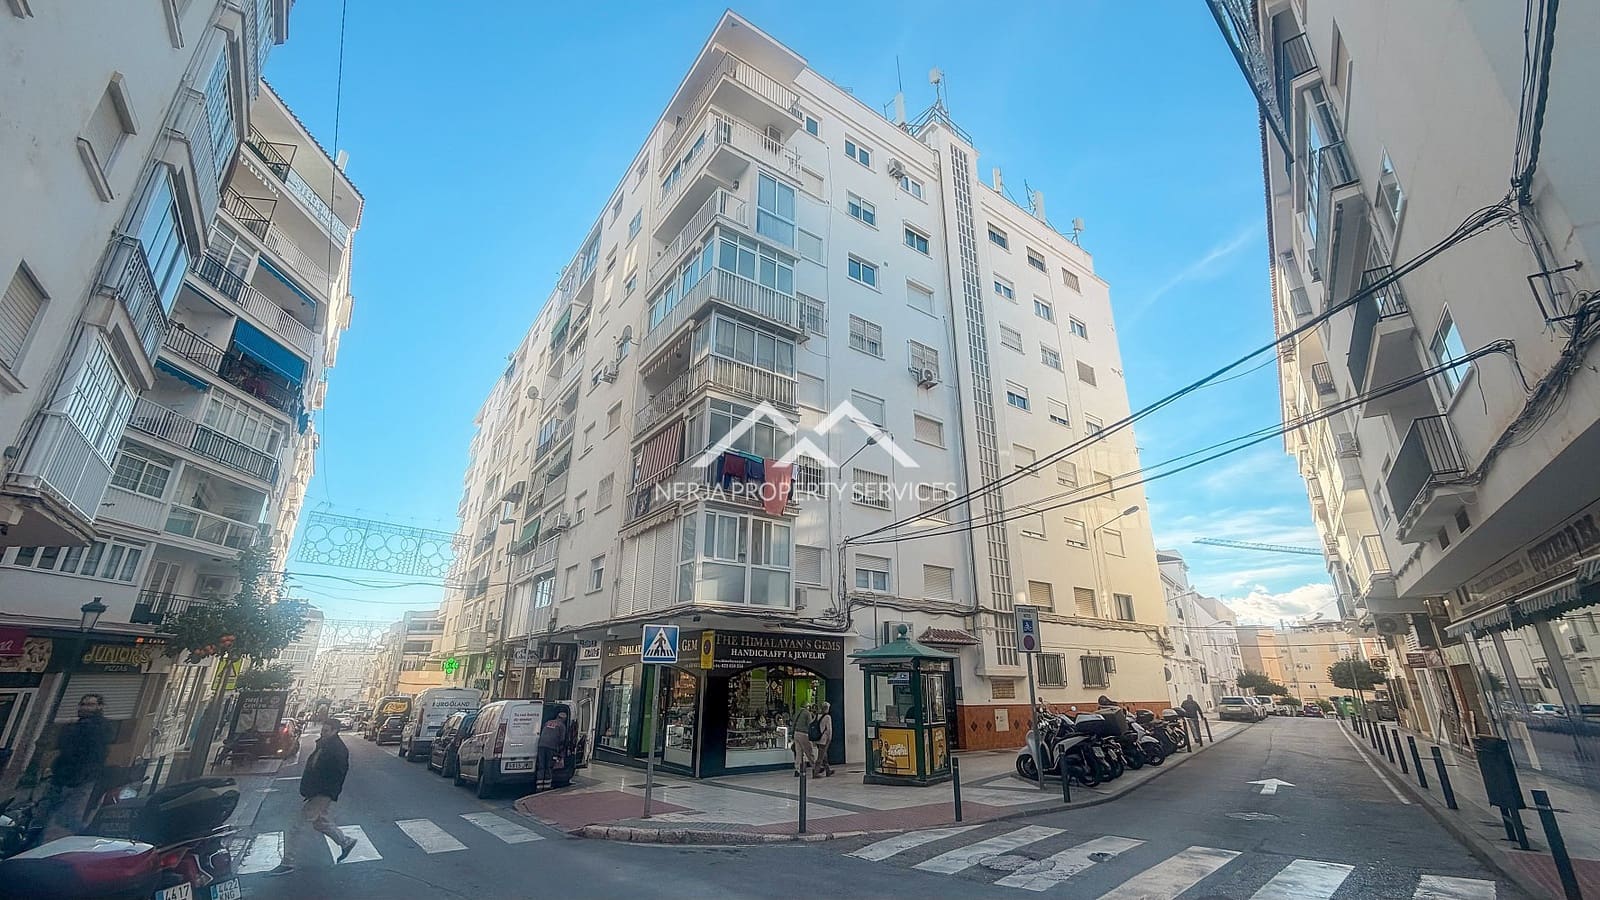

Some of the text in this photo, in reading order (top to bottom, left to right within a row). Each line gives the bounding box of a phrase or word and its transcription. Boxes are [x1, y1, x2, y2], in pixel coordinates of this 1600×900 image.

[716, 634, 840, 651] THE HIMALAYAN'S GEMS
[794, 651, 826, 660] JEWELRY
